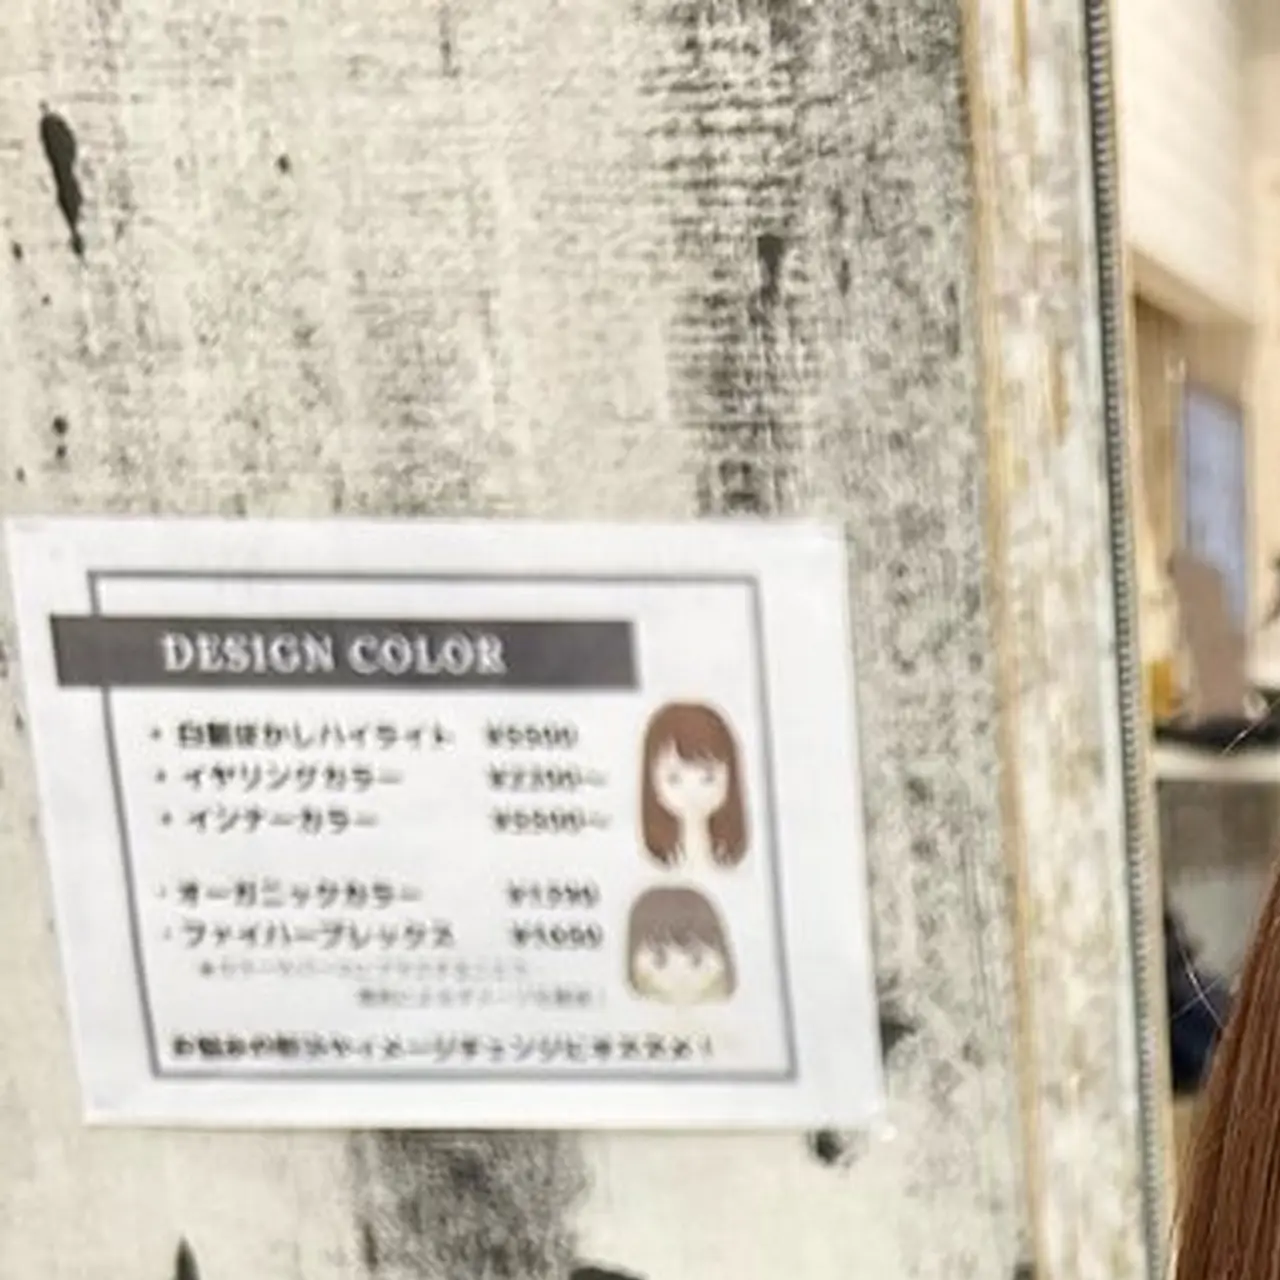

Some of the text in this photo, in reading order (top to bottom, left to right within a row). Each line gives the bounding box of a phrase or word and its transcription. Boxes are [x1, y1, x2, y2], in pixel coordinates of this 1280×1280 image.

[161, 632, 506, 675] DESIGN COLOR
[182, 762, 404, 792] イヤリングカラー
[187, 804, 379, 835] インナーカラー
[178, 879, 421, 909] オーガニックカラー
